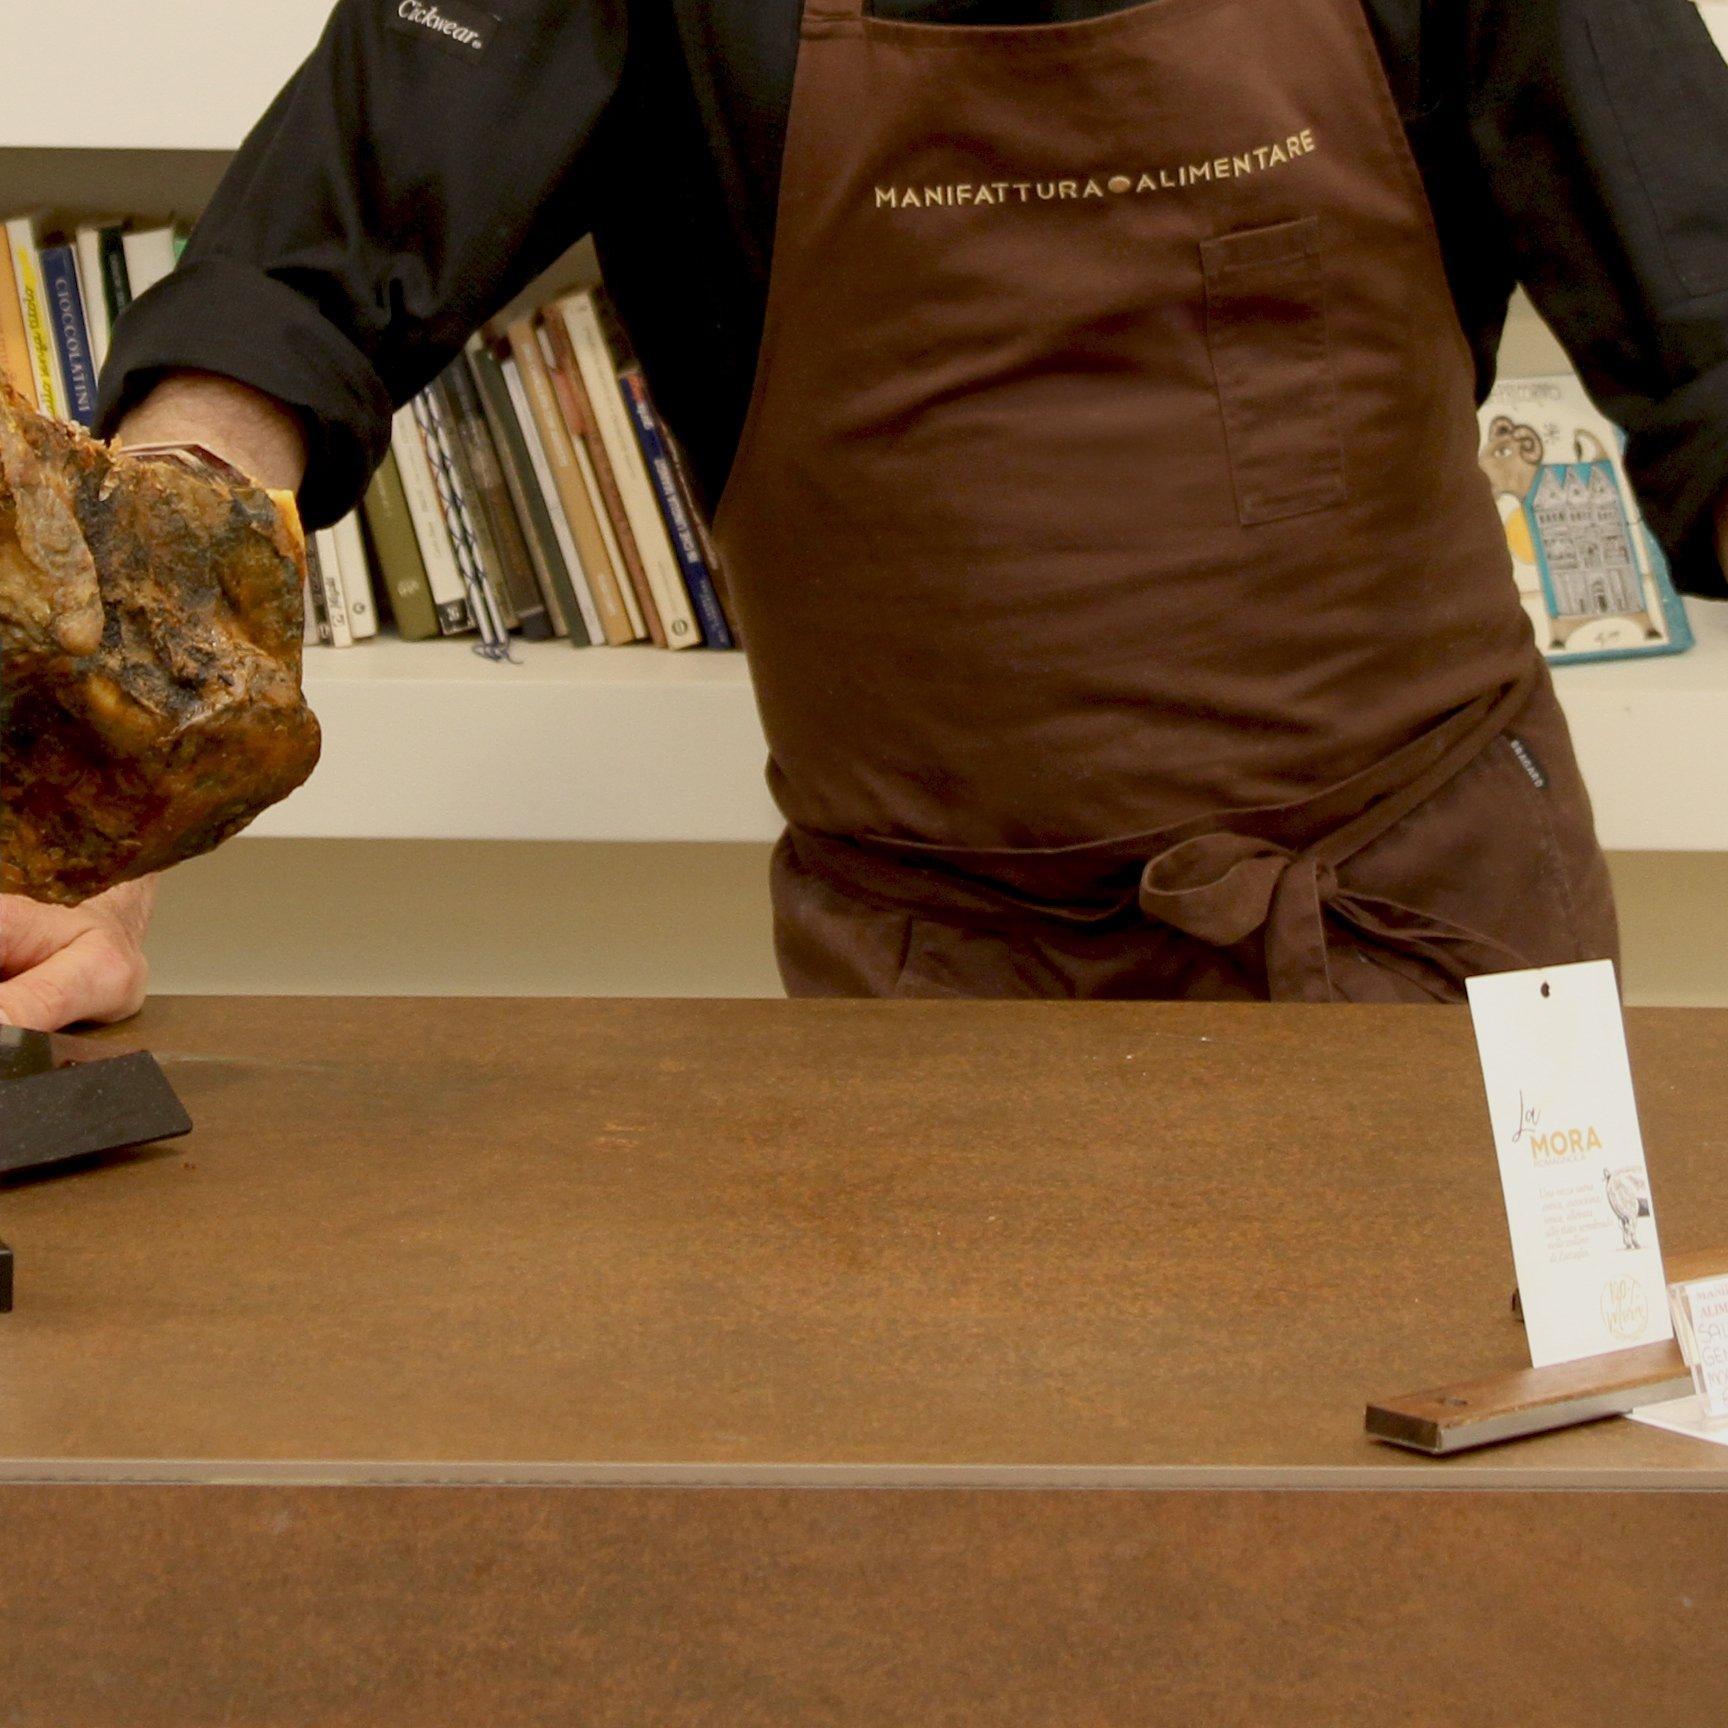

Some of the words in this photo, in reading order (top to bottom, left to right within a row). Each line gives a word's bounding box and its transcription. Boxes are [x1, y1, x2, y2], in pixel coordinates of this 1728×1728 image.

[873, 179, 1105, 209] MANIFATTURA
[1134, 127, 1317, 194] ALIMENTARE
[52, 276, 91, 413] CIOCCOLATINI
[1530, 1126, 1602, 1160] MORA
